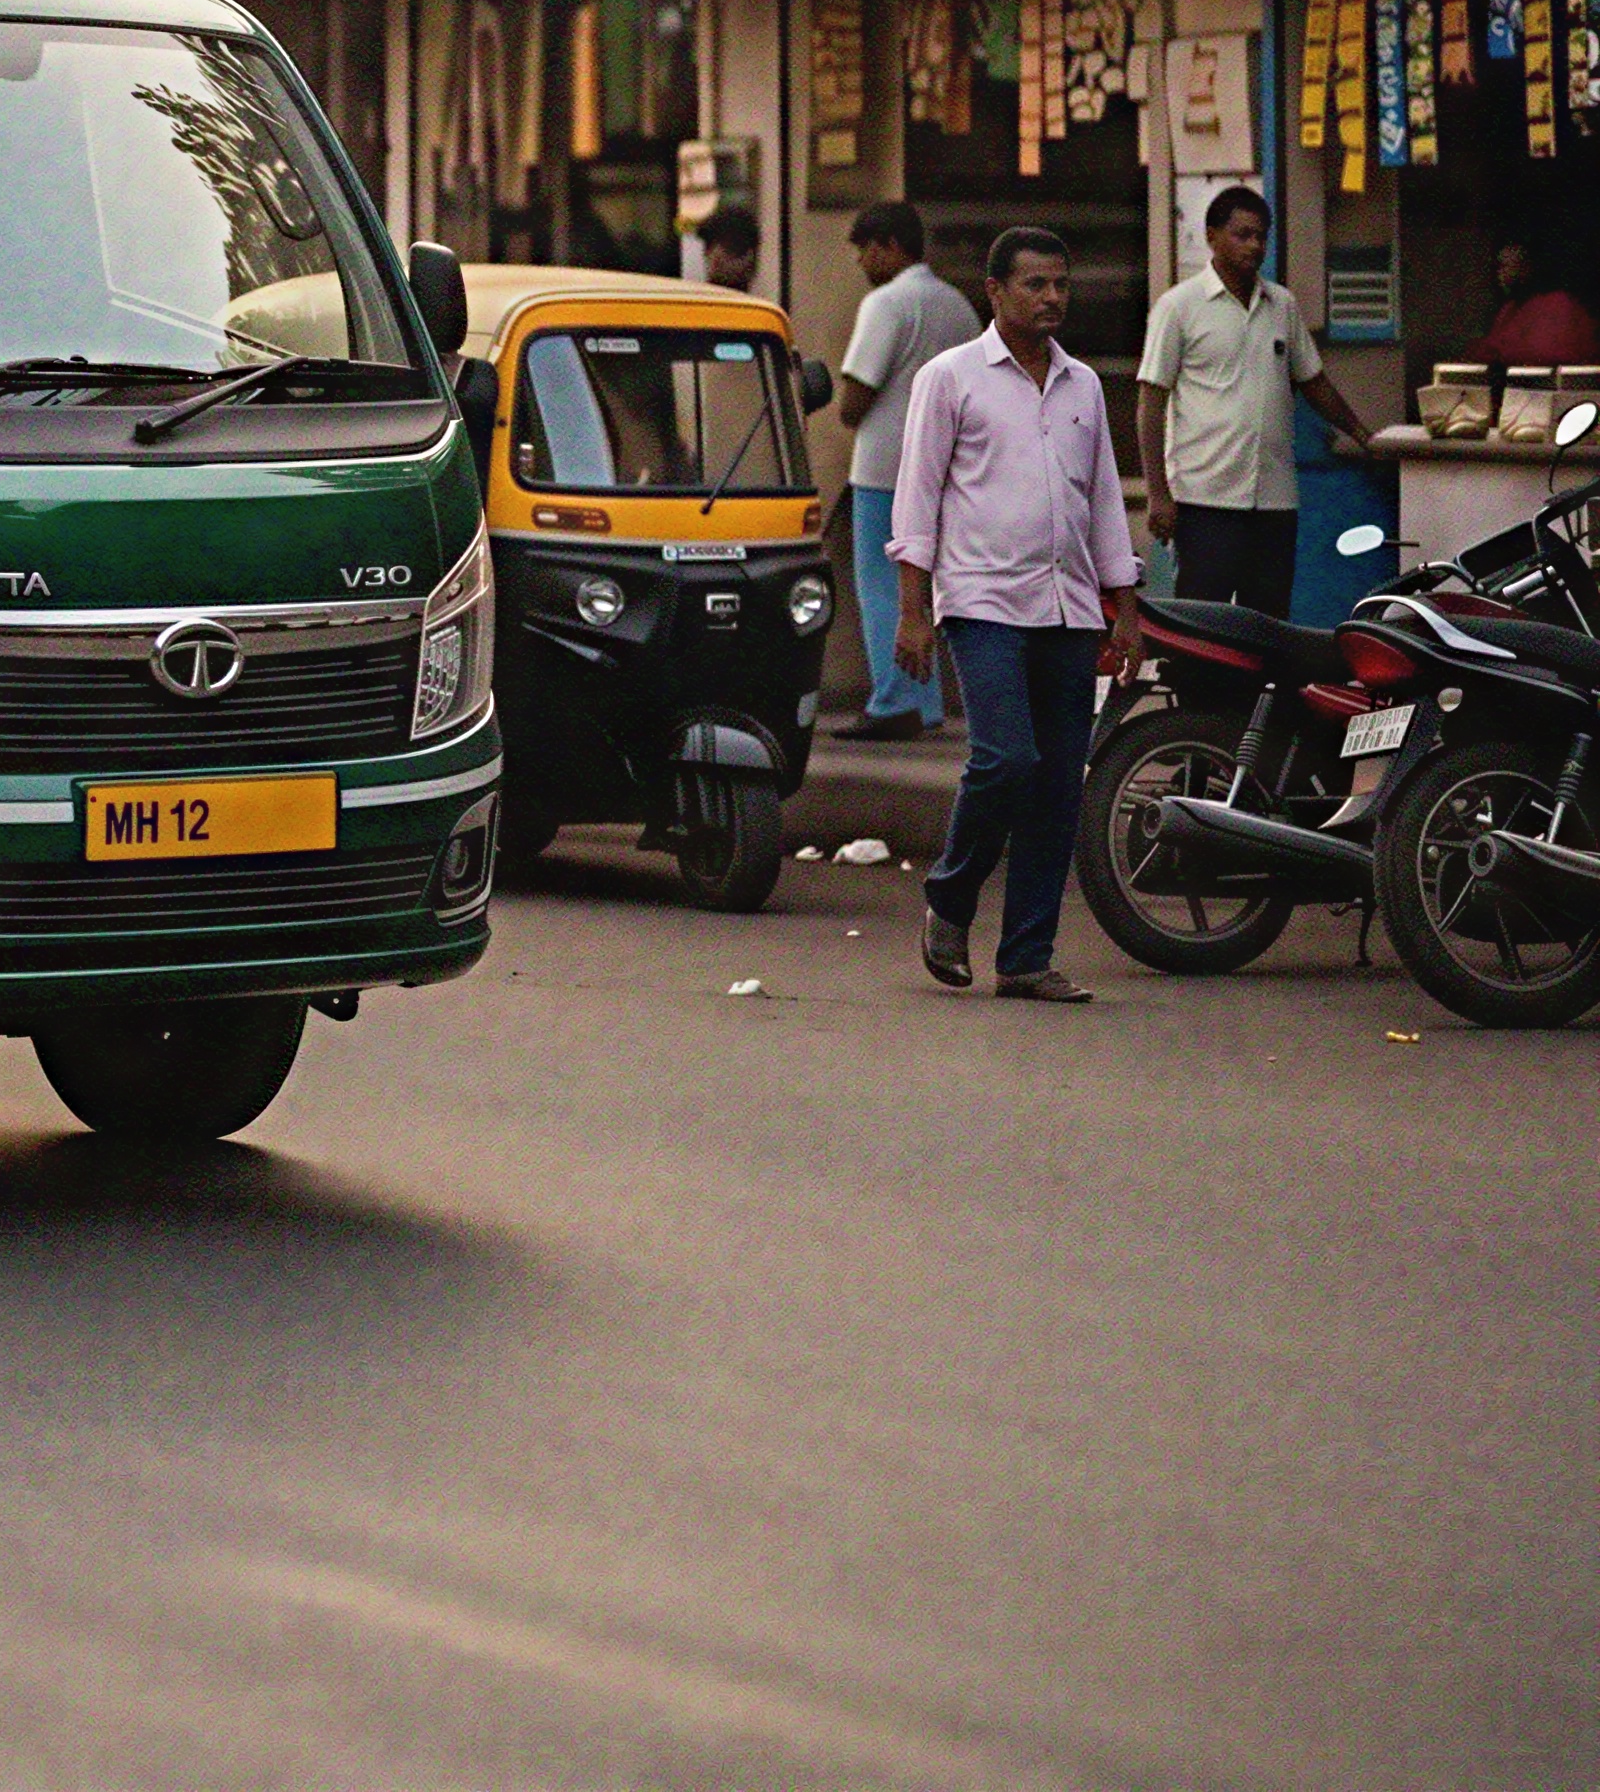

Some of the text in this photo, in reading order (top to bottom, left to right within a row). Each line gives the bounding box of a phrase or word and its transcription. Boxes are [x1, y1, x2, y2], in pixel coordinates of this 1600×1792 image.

[340, 565, 413, 588] V30
[105, 798, 210, 845] MH 12
